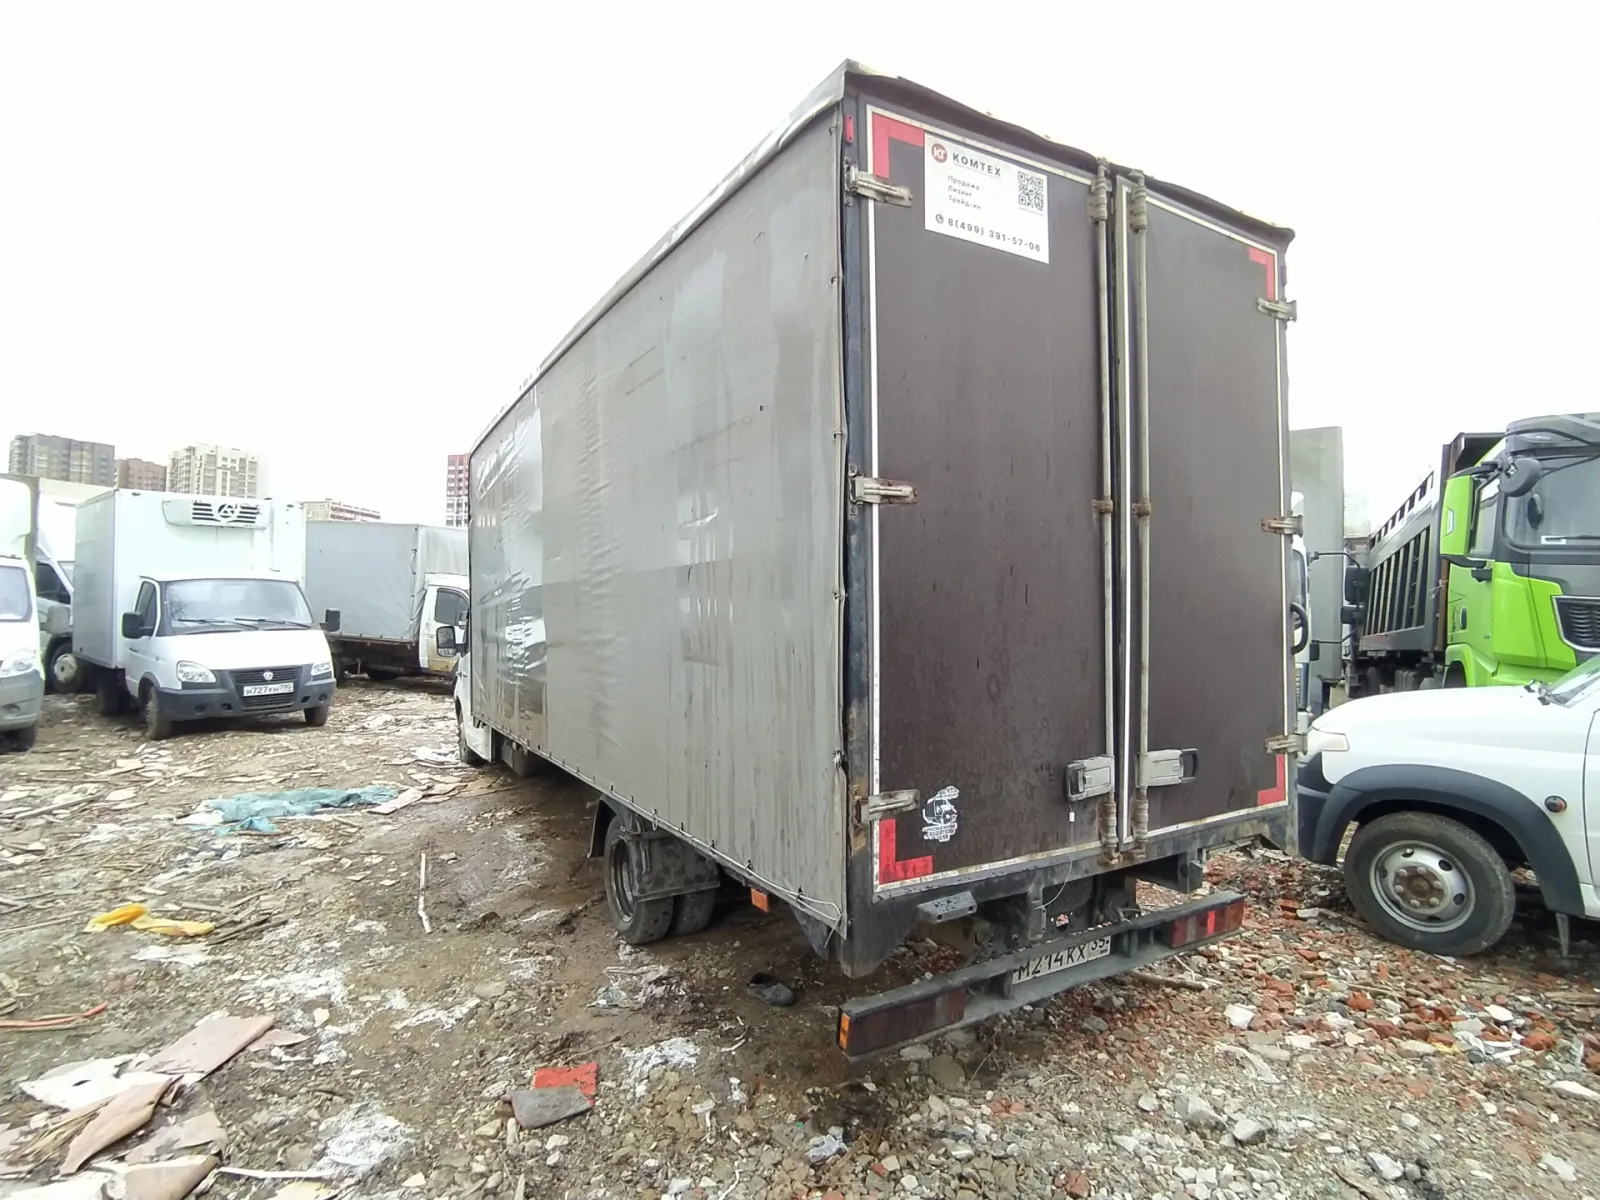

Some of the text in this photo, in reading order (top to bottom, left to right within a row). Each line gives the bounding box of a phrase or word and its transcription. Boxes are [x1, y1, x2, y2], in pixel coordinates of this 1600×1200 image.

[952, 152, 1001, 177] КОМТЕХ
[948, 217, 1041, 252] 8(499) 391-57-06
